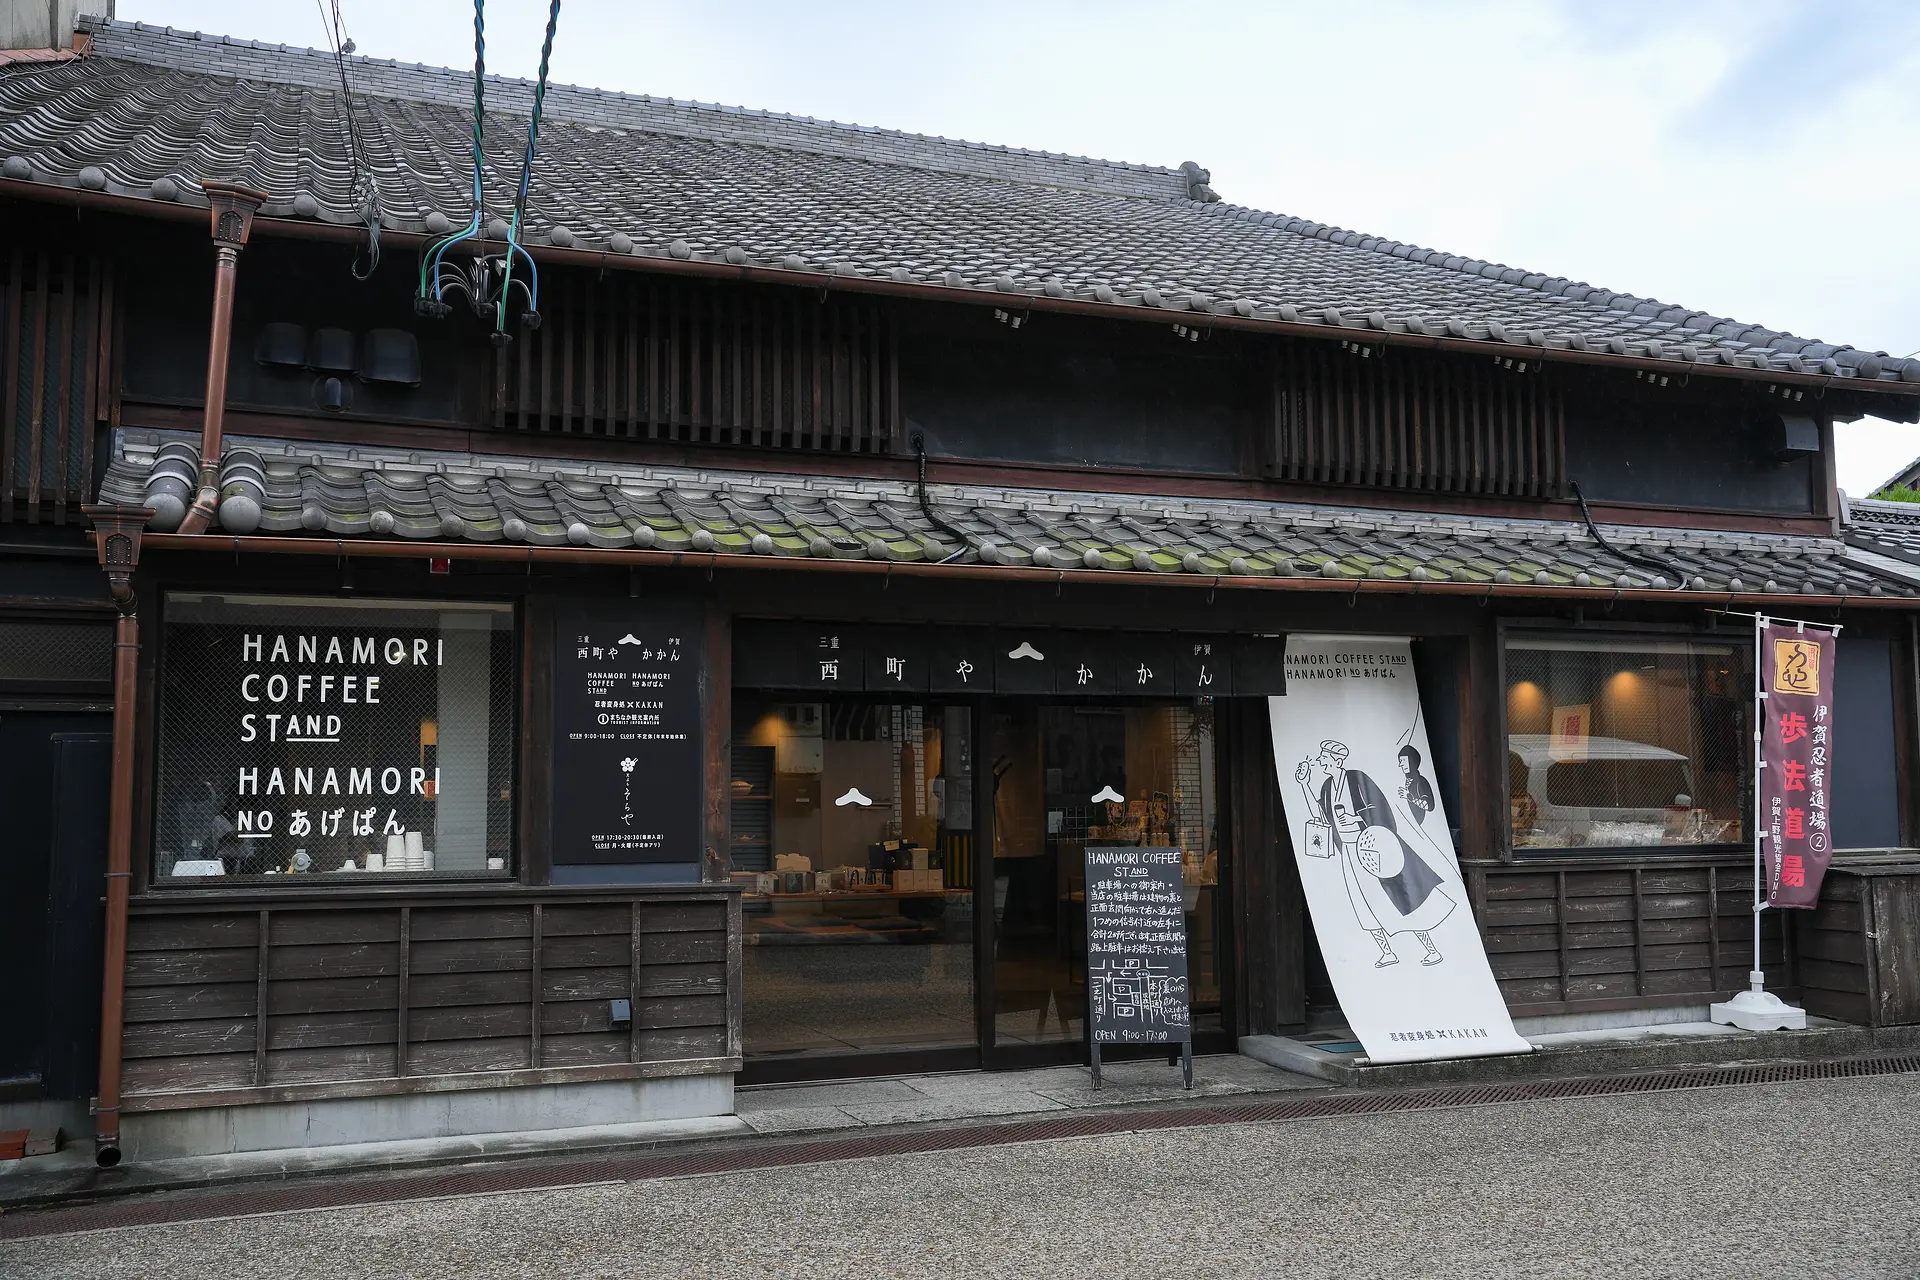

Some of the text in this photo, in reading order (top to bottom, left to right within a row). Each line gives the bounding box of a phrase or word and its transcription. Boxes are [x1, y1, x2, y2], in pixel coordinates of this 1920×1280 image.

[820, 636, 840, 649] 三重
[243, 634, 443, 666] HANAMORI
[577, 647, 680, 661] 西町や かかん
[1194, 644, 1211, 656] 伊賀
[1334, 653, 1375, 665] COFFEE
[1379, 654, 1407, 665] STAND
[587, 672, 627, 680] HANAMORI
[632, 672, 671, 680] HANAMORI
[820, 657, 1213, 686] 西町や かかん
[1286, 667, 1396, 680] HANAMORI NO あげぱん
[241, 674, 380, 703] COFFEE
[241, 714, 341, 742] STAND
[238, 767, 441, 795] HANAMORI
[238, 807, 406, 838] NO あげぱん
[1088, 852, 1182, 865] HANAMORI COFFEE
[1113, 866, 1149, 878] STAND
[1095, 1029, 1117, 1040] OPEN
